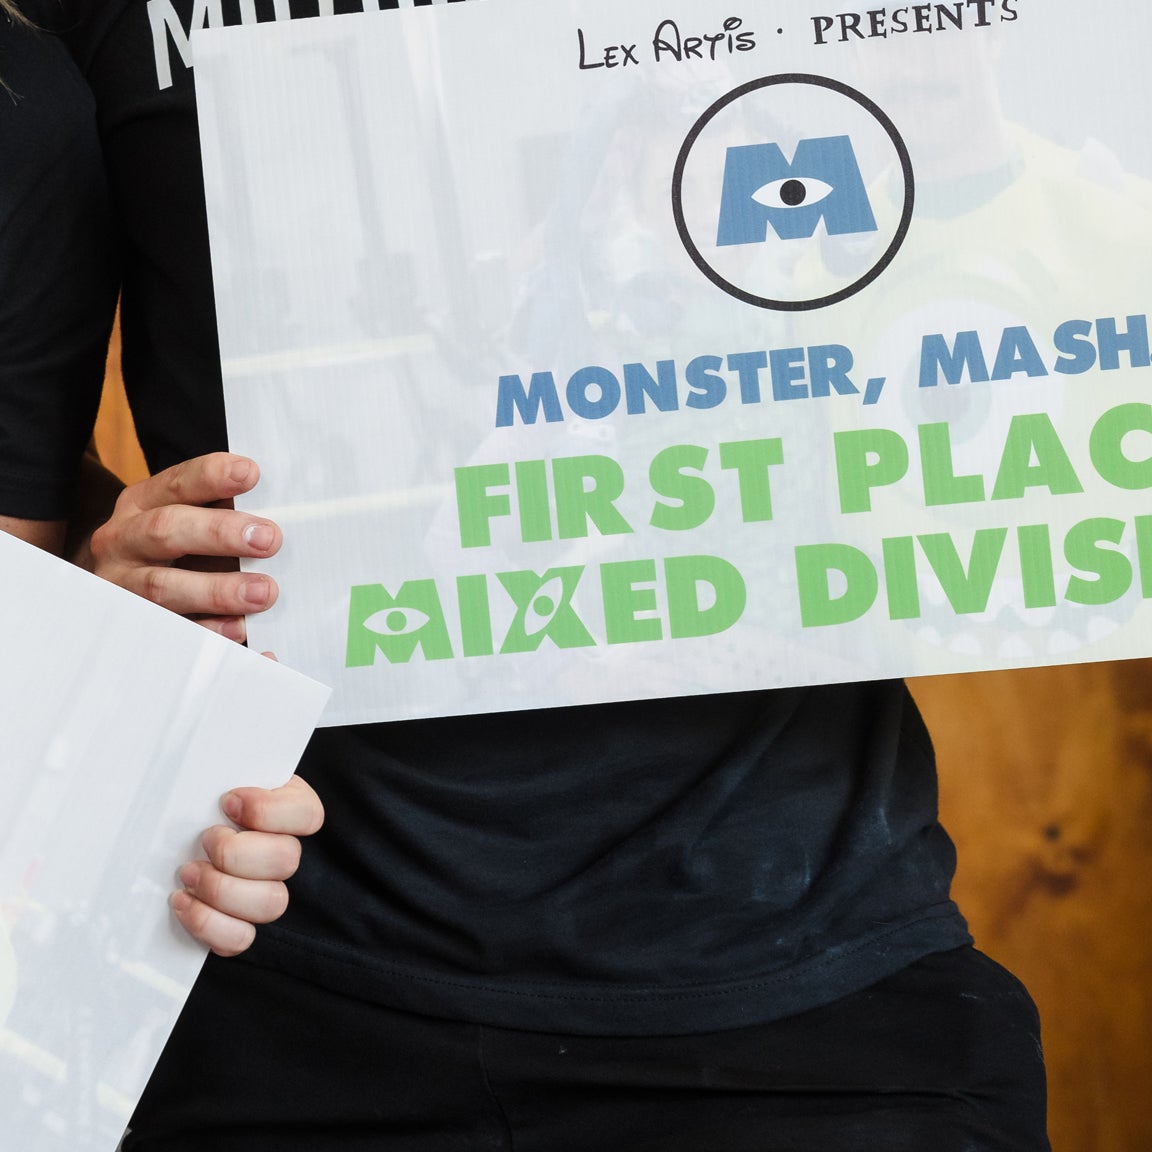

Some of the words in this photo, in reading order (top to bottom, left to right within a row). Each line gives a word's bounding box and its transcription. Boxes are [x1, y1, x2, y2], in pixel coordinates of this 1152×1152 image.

[496, 345, 884, 427] MONSTER,
[920, 316, 1152, 387] MASH
[456, 438, 783, 547] FIRST
[346, 556, 746, 666] MIXED
